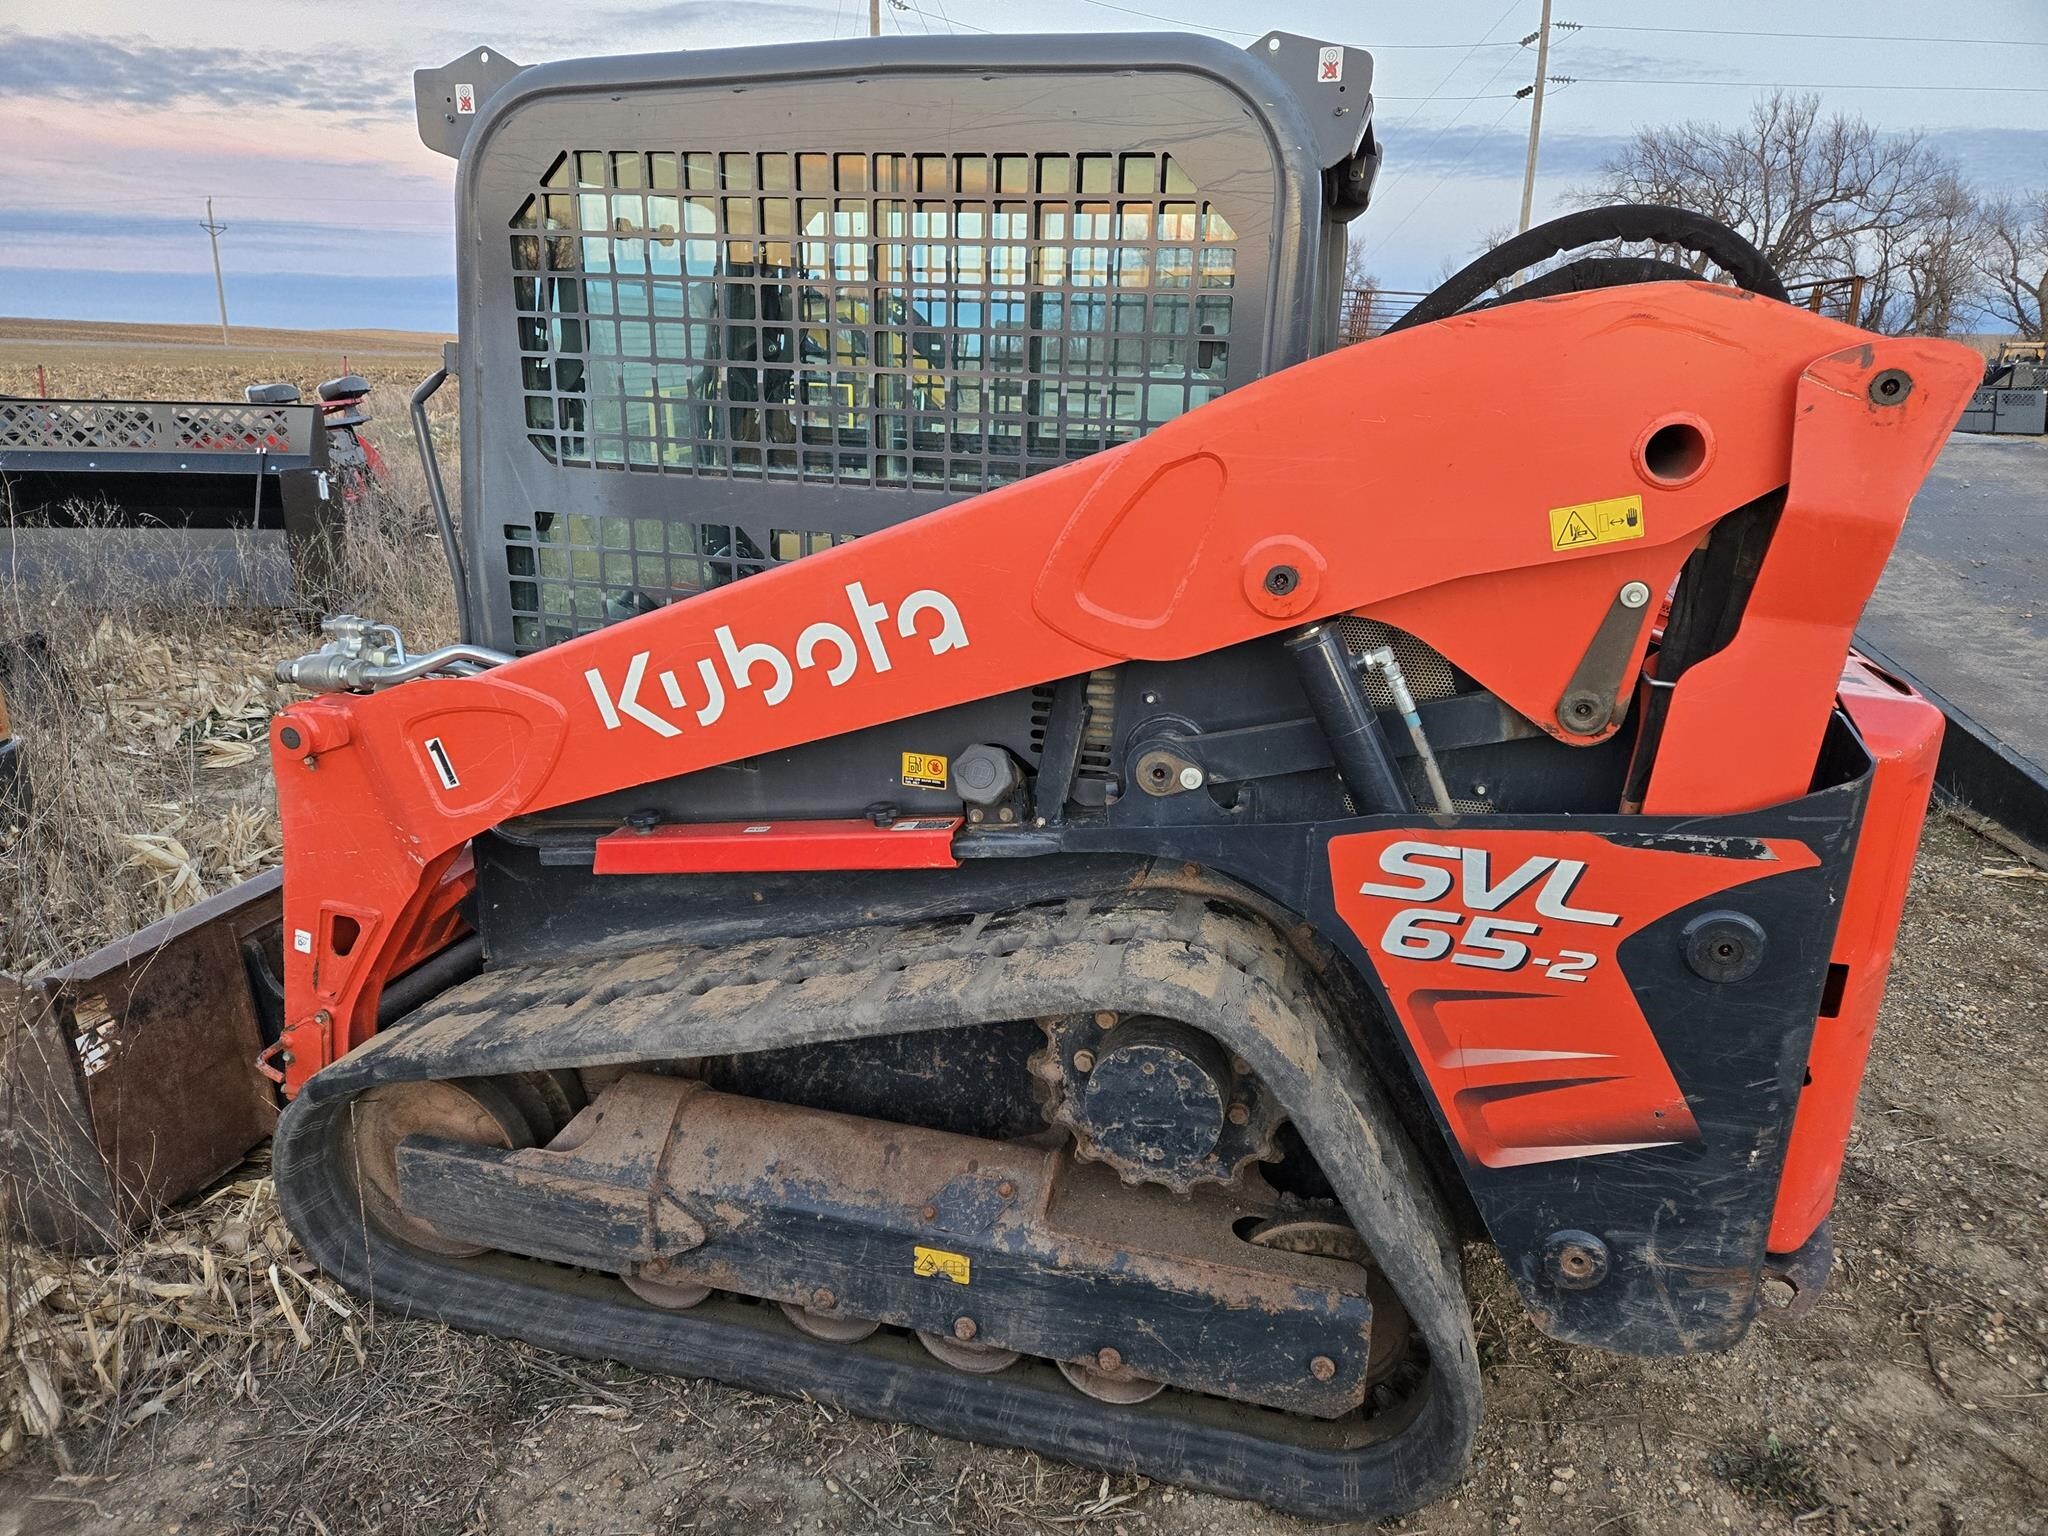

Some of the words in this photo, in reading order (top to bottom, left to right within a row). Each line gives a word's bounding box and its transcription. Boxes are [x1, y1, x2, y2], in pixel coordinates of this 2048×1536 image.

[584, 581, 970, 738] Kubota
[429, 739, 457, 786] 1
[1359, 840, 1622, 927] SVL
[1380, 908, 1598, 982] 65-2
